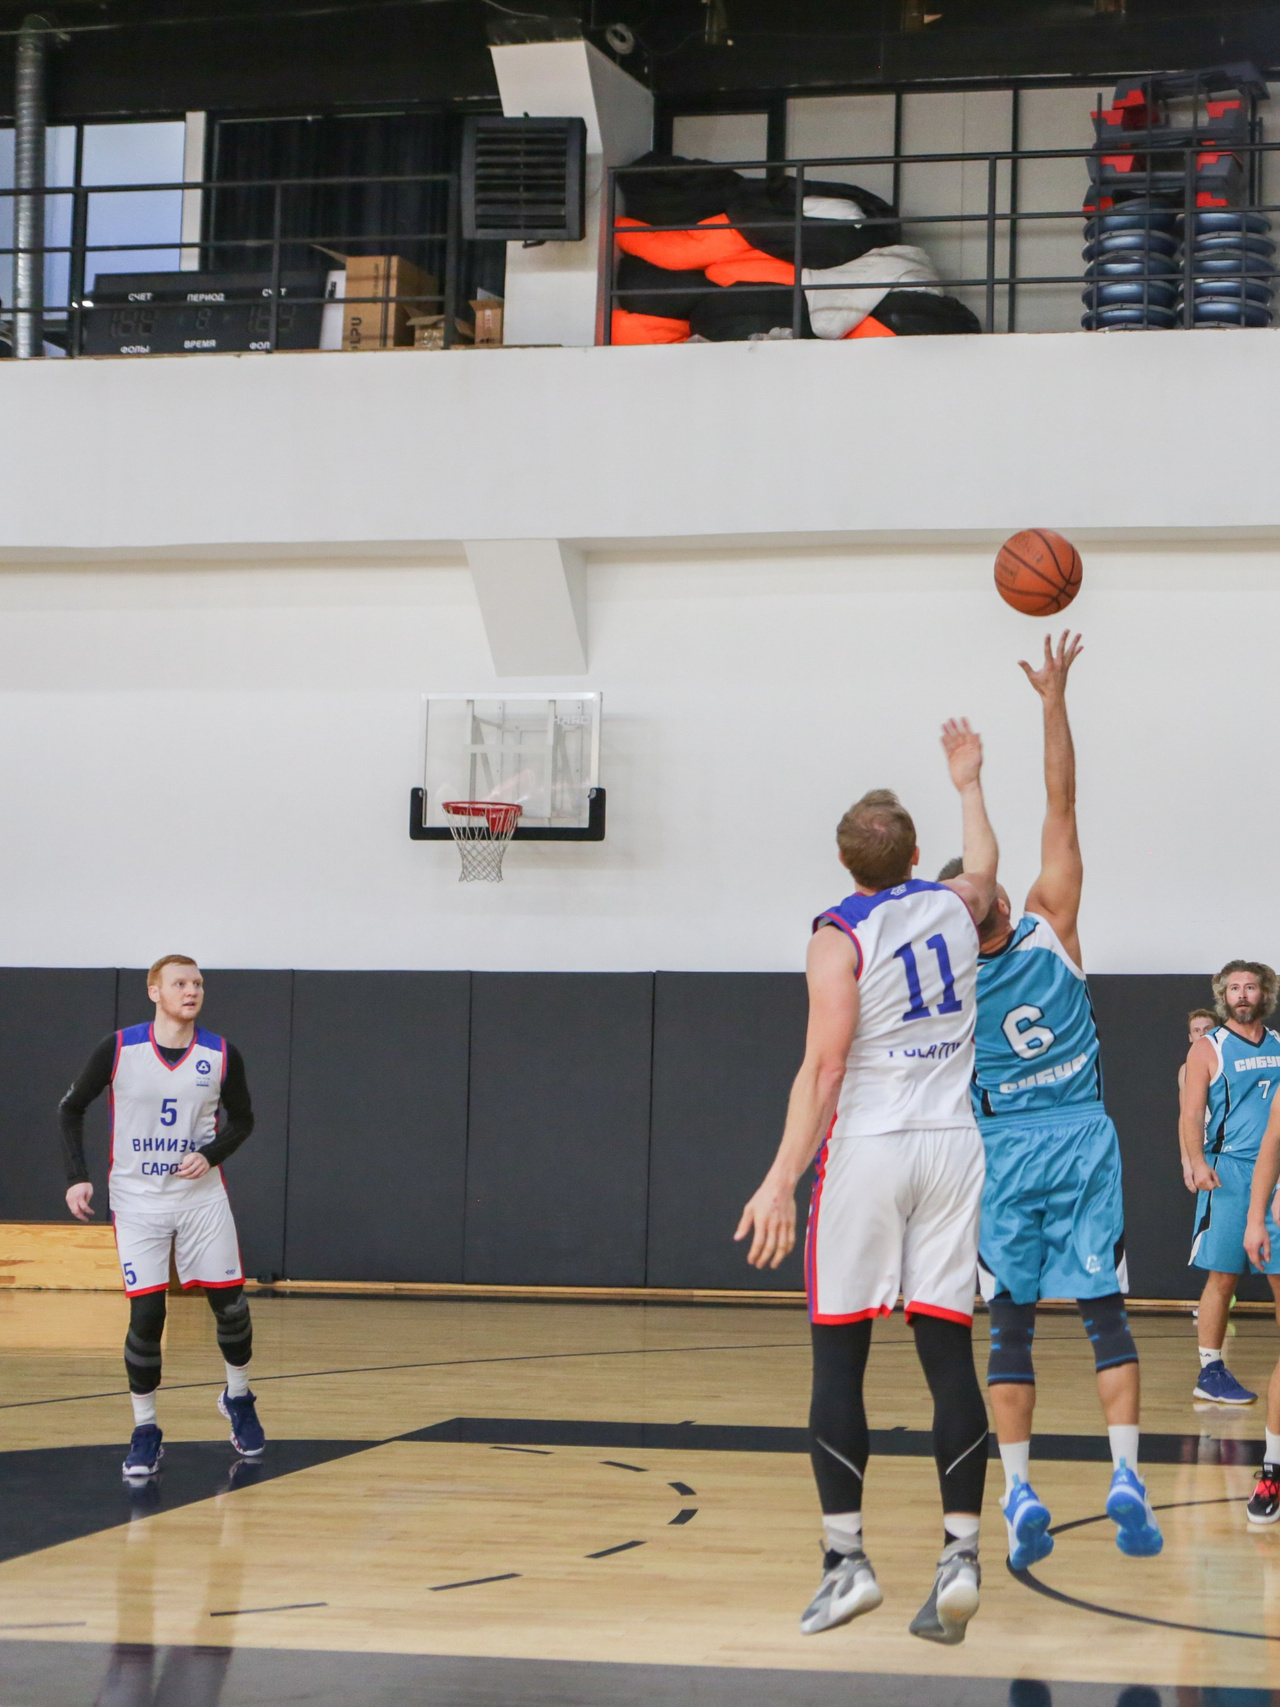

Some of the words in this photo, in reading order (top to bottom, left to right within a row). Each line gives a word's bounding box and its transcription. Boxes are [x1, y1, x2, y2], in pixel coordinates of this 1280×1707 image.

[186, 293, 225, 302] ПЕРИОД
[183, 340, 216, 349] ВРЕМЯ
[249, 341, 270, 350] ФОЛ
[893, 933, 963, 1022] 11
[1001, 1003, 1056, 1060] 6
[1258, 1080, 1271, 1099] 7
[160, 1098, 178, 1127] 5
[141, 1162, 182, 1176] САРО
[123, 1262, 137, 1286] 5
